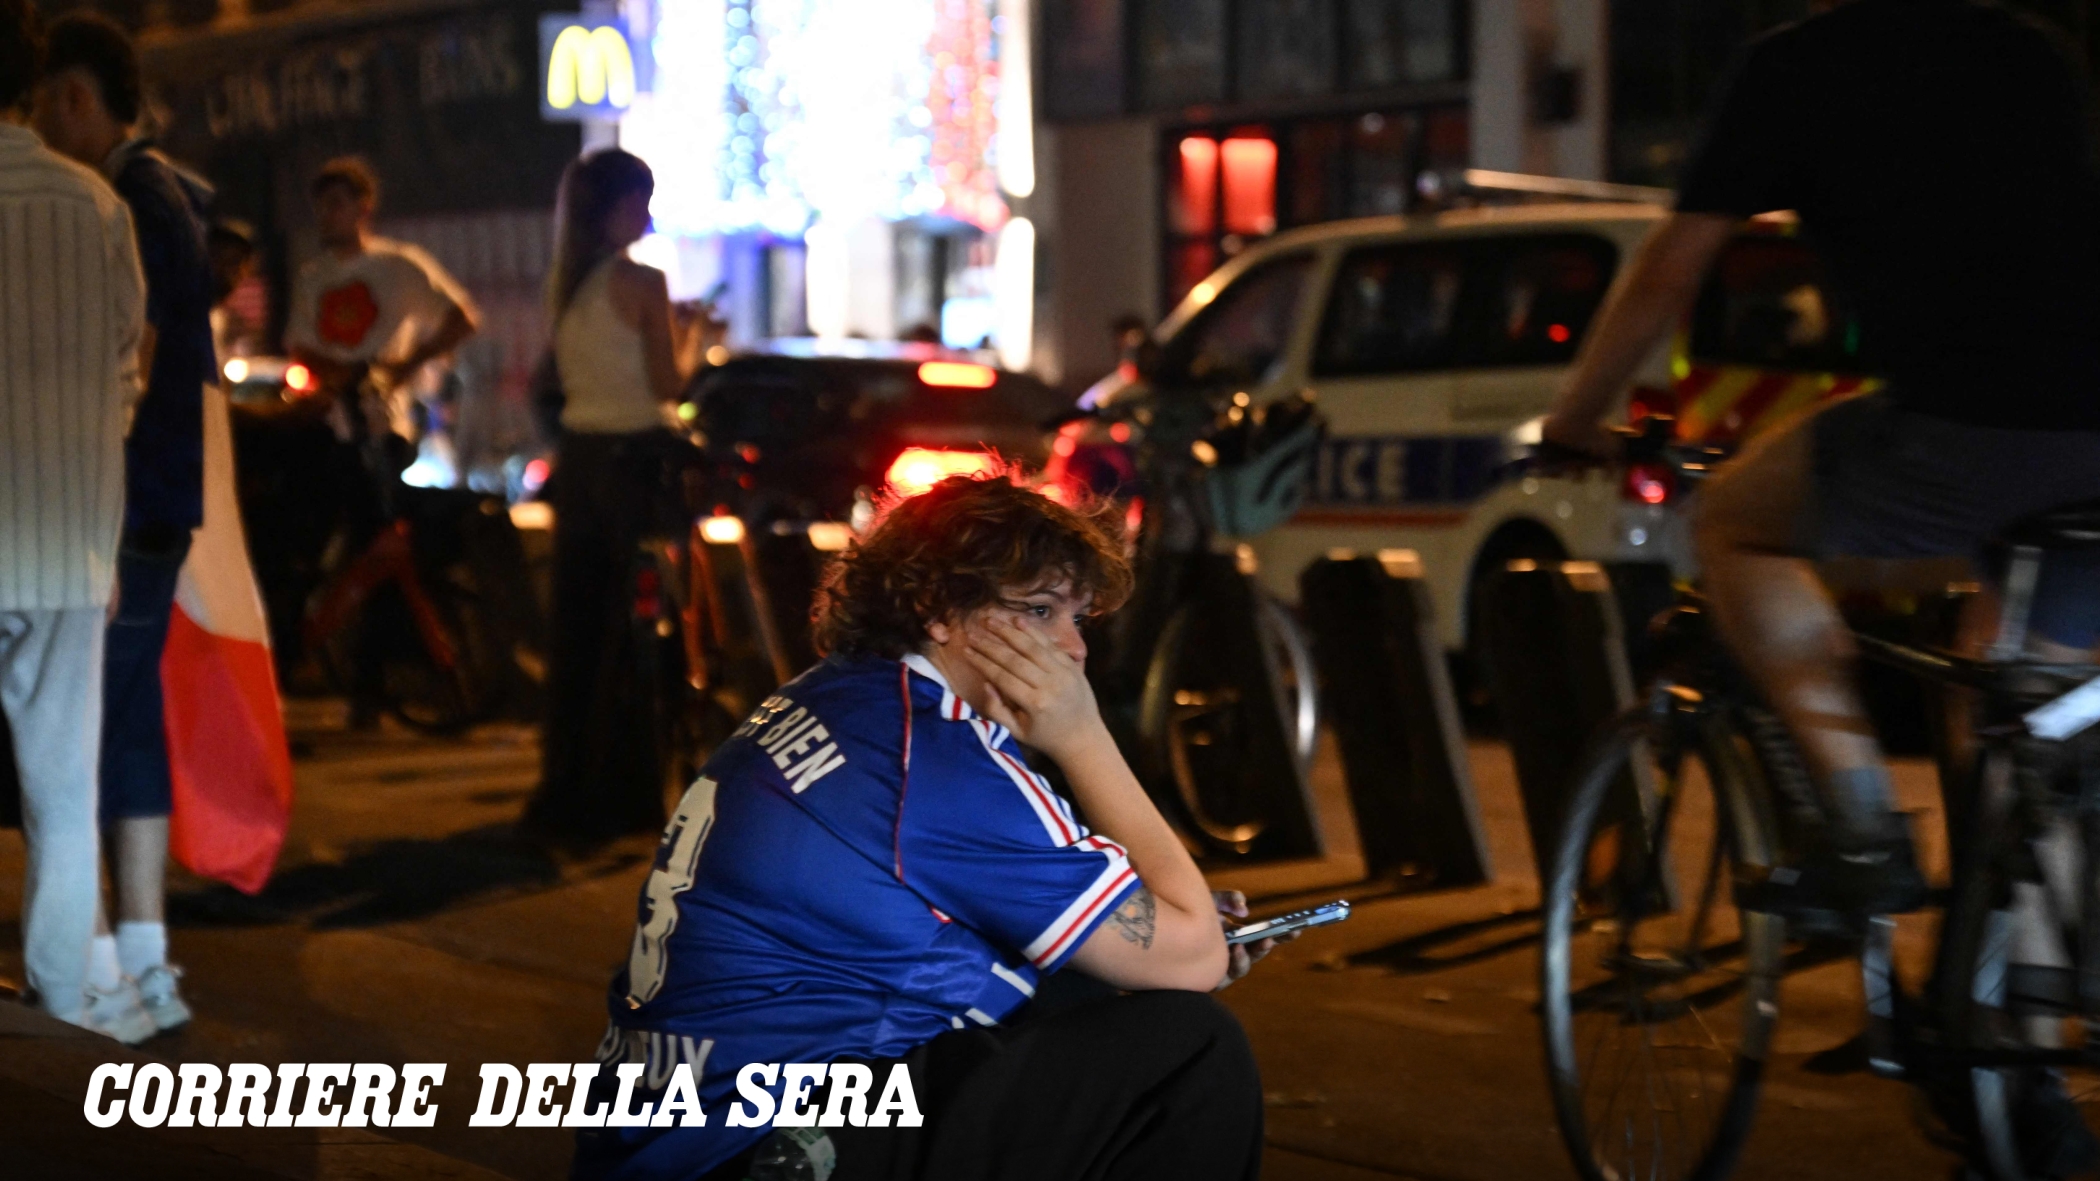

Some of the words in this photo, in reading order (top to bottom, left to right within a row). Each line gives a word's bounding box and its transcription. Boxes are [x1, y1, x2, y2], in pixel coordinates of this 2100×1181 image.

[547, 25, 636, 109] M
[1316, 444, 1406, 498] ICE
[756, 706, 847, 794] BIEN
